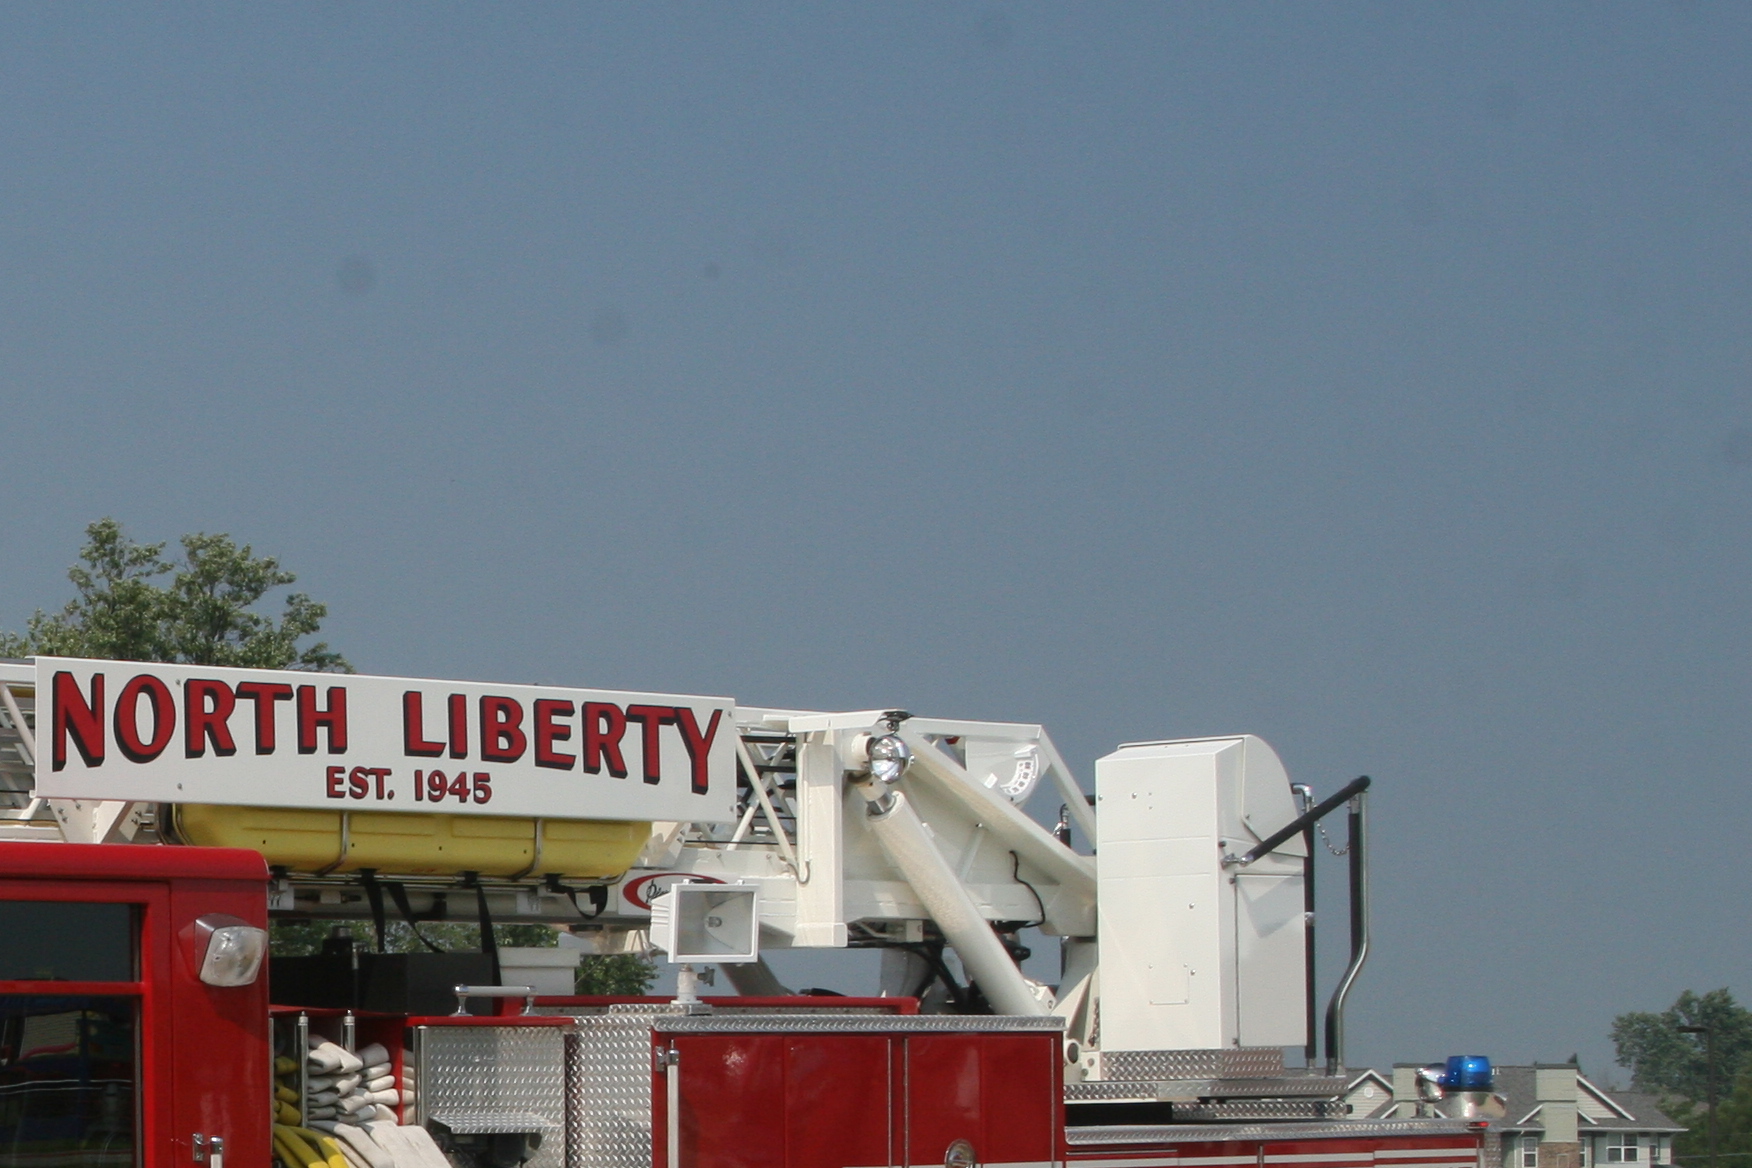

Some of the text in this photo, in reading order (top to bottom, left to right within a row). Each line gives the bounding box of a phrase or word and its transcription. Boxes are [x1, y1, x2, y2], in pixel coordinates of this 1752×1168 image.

[51, 671, 723, 796] NORTH LIBERTY
[326, 766, 493, 804] EST. 1945
